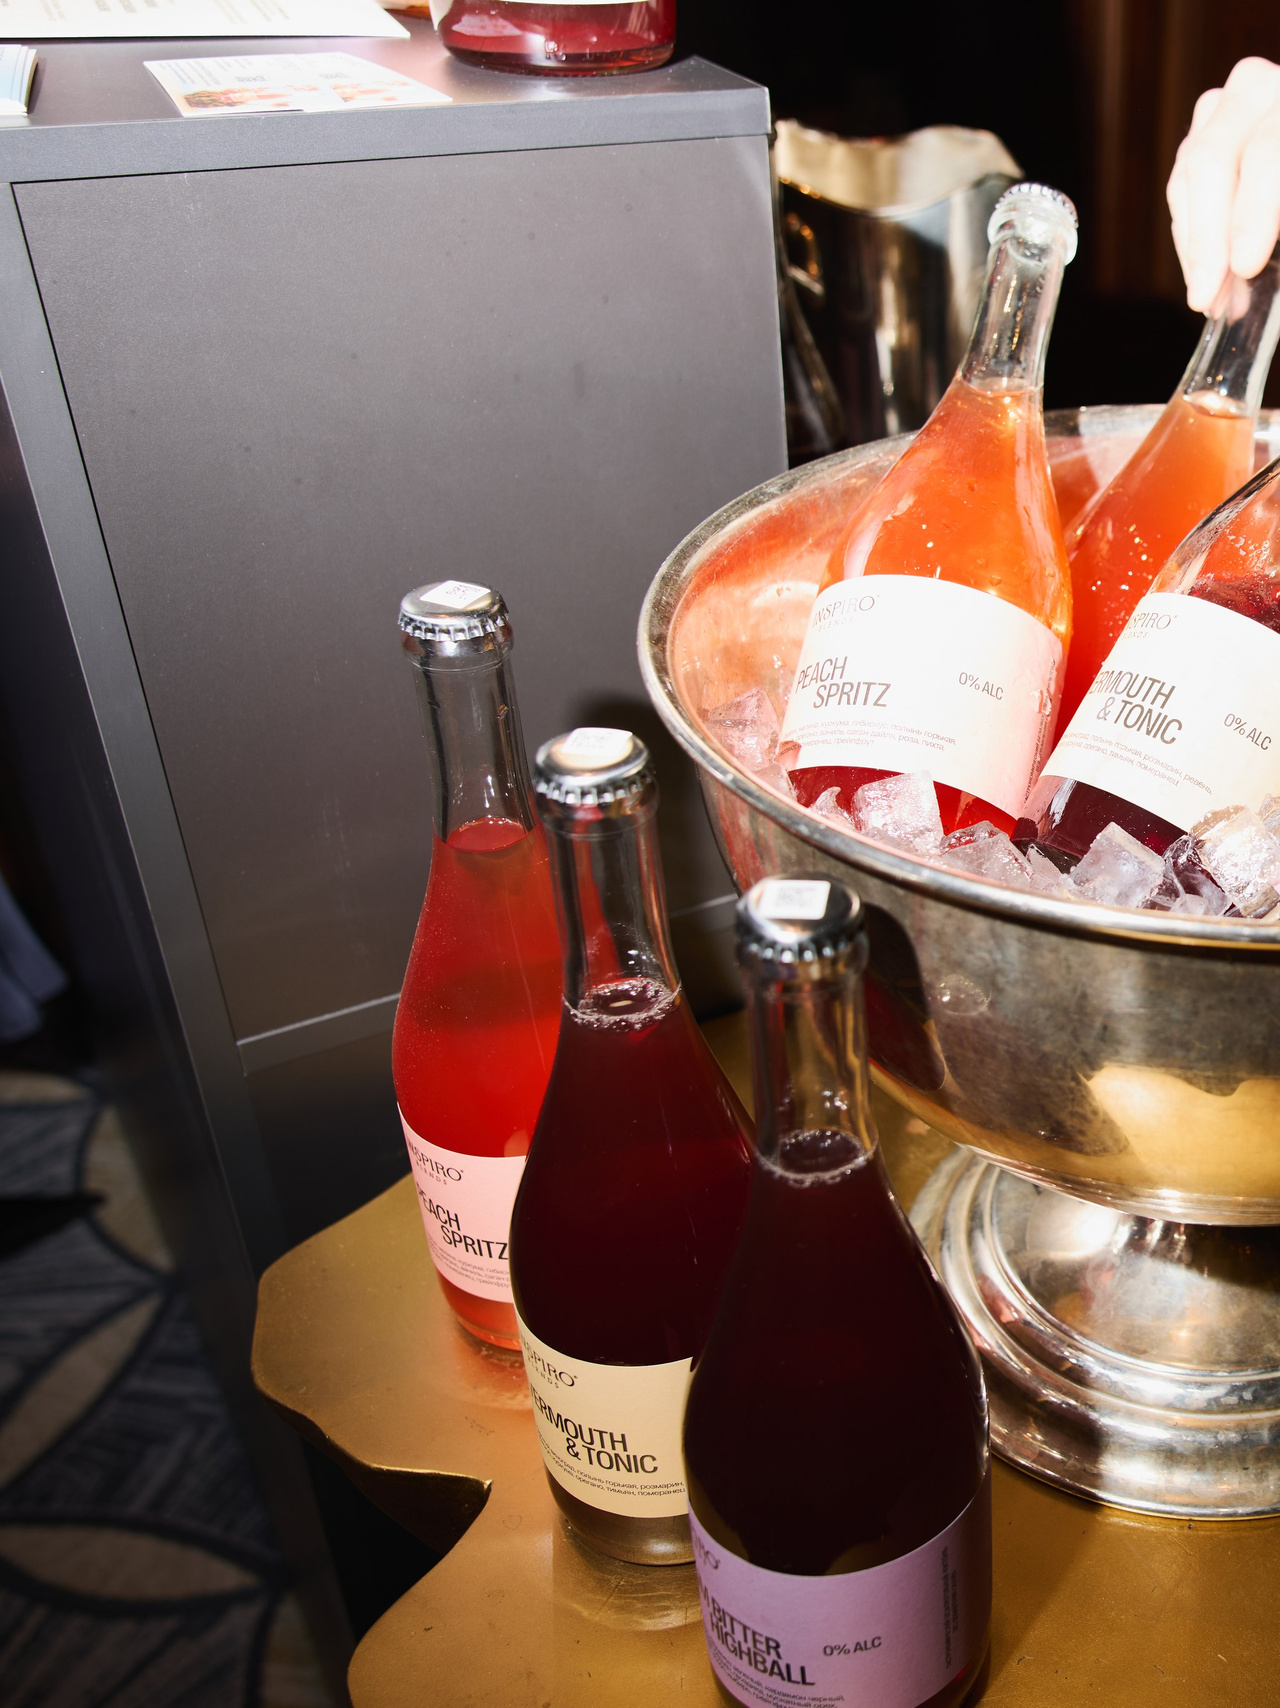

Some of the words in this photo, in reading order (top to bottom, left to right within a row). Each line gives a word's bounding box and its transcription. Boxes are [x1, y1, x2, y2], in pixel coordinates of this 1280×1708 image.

[795, 656, 848, 695] PEACH
[958, 671, 981, 692] 0%
[982, 681, 1004, 701] ALC
[1089, 670, 1176, 710] ERMOUTH
[812, 681, 892, 709] SPRITZ
[923, 730, 957, 746] горькая,
[1096, 696, 1116, 721] &
[1113, 699, 1183, 745] TONIC
[1223, 713, 1247, 736] 0%
[1245, 727, 1273, 751] ALC
[898, 734, 920, 746] роза,
[921, 739, 945, 752] пихта,
[1142, 753, 1183, 778] розмарин,
[1183, 773, 1213, 796] ревень,
[416, 1181, 461, 1231] PEACH
[440, 1225, 509, 1260] SPRITZ
[530, 1382, 629, 1453] VERMOUTH
[566, 1437, 582, 1461] &
[582, 1444, 659, 1475] TONIC
[605, 1480, 639, 1489] горькая,
[640, 1481, 685, 1492] розмарин,
[711, 1596, 783, 1659] BITTER
[823, 1643, 851, 1656] 0%
[853, 1636, 883, 1655] ALC
[710, 1612, 816, 1686] HIGHBALL
